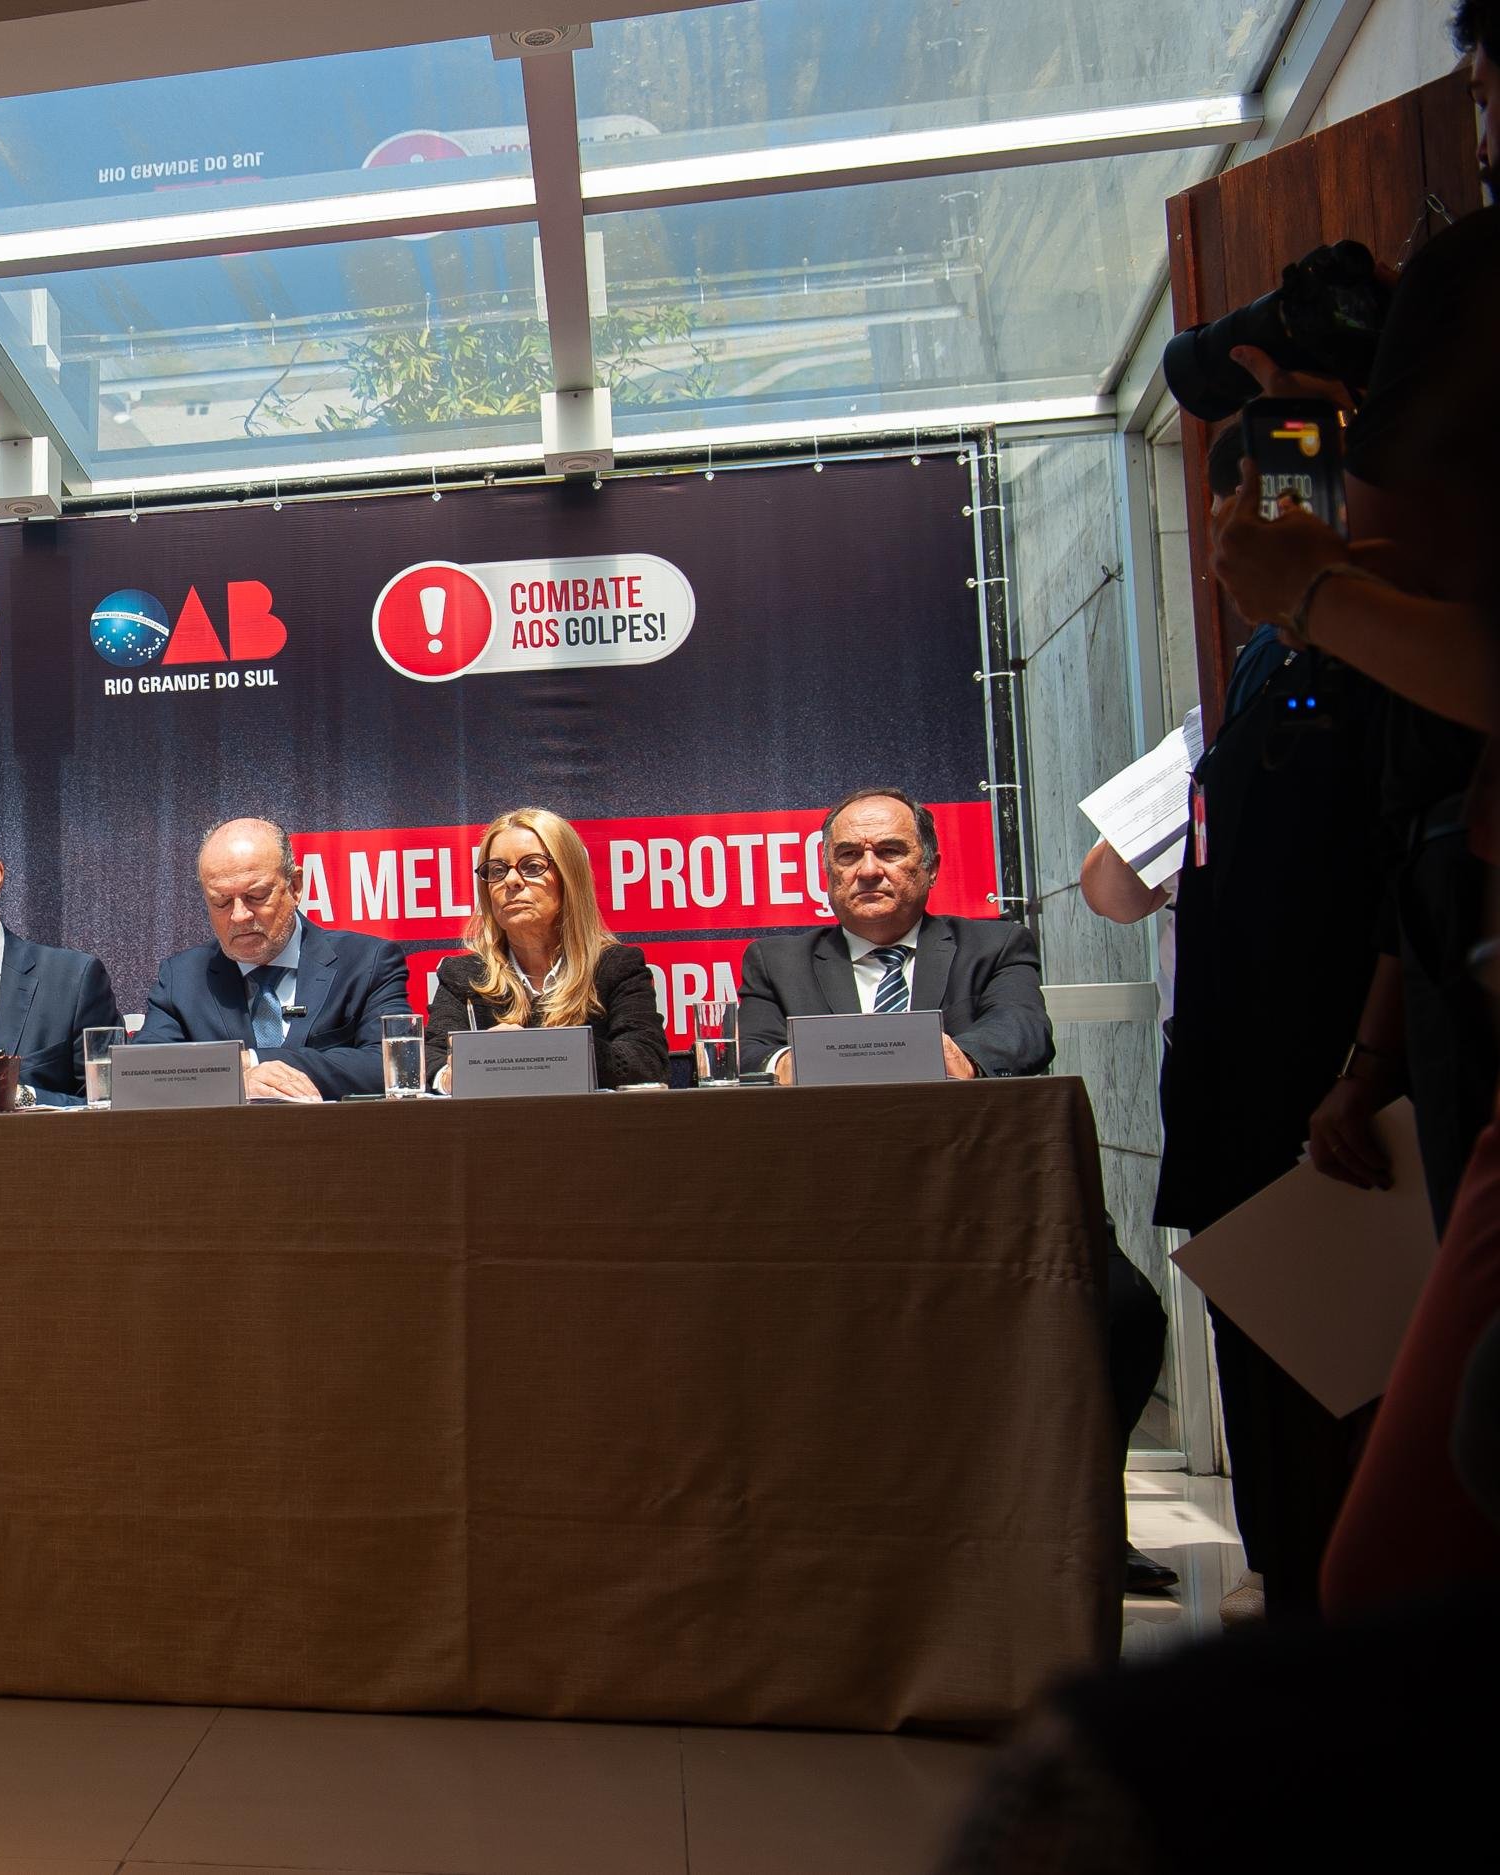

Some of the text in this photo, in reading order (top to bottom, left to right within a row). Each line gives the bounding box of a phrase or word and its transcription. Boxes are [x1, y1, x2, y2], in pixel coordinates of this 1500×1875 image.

[510, 576, 643, 615] COMBATE
[512, 612, 667, 650] AOS GOLPES!
[104, 669, 278, 695] RIO GRANDE DO SUL
[299, 853, 335, 922] A
[497, 1056, 514, 1064] LÚCIA
